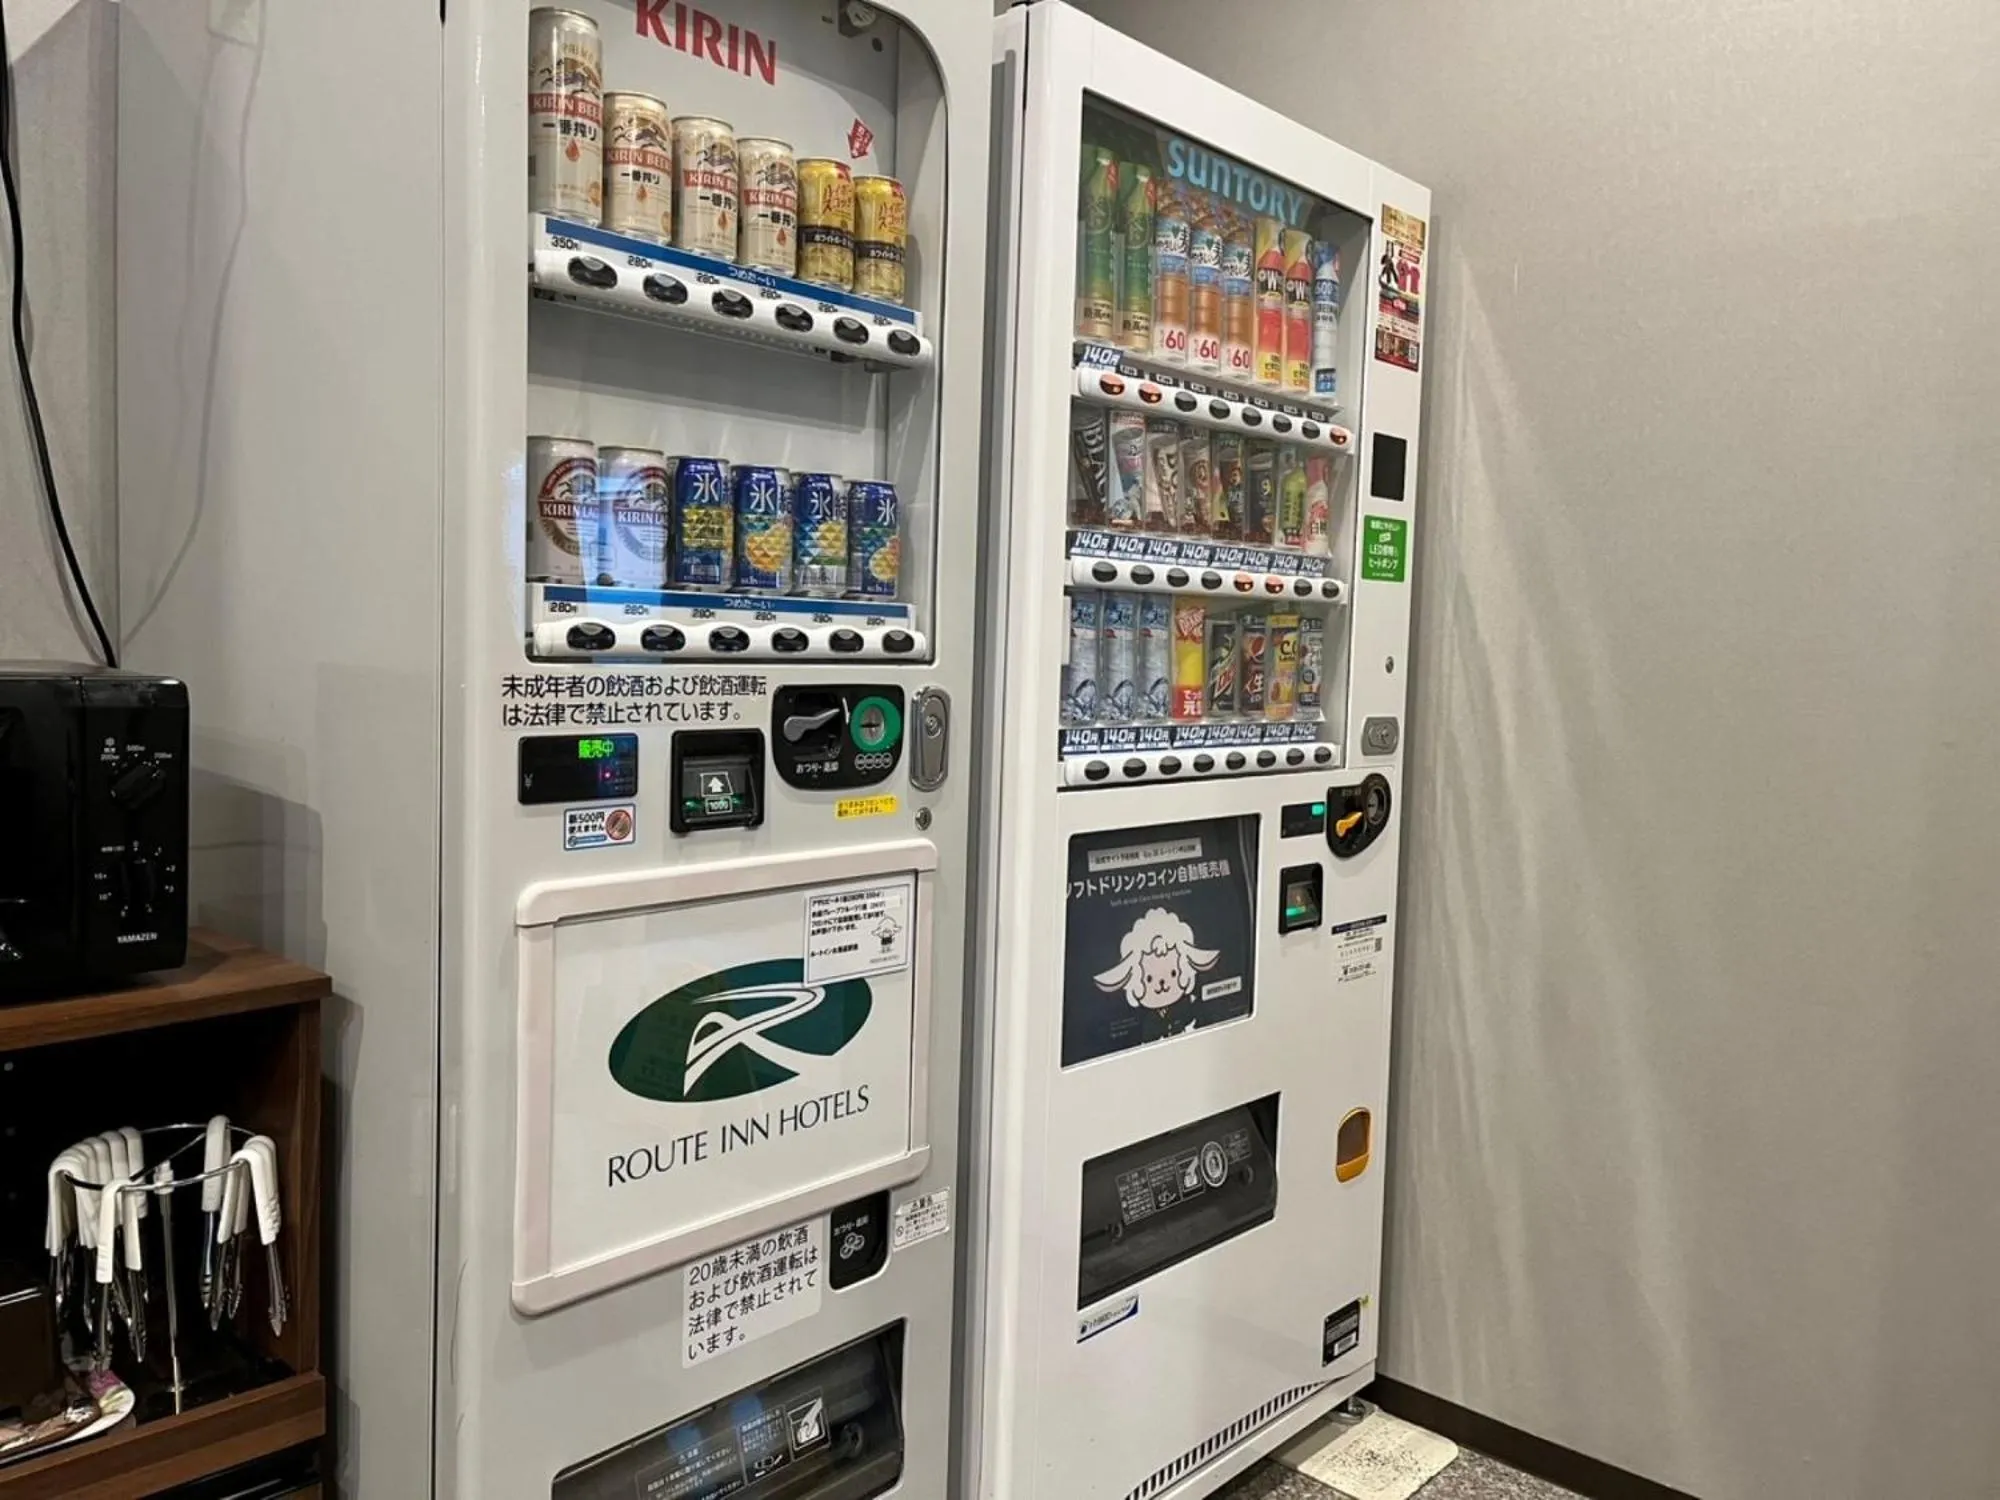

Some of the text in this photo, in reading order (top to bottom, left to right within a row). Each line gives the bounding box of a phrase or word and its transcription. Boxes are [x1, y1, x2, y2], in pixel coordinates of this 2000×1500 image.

[636, 0, 776, 85] KIRIN
[542, 119, 597, 141] 一番搾り
[1165, 330, 1186, 349] 60
[1199, 339, 1219, 360] 60
[1232, 349, 1250, 369] 60
[543, 503, 580, 518] KIRIN
[618, 511, 653, 524] KIRIN
[502, 675, 767, 699] 未成年者の飲酒および飲酒運転
[503, 701, 742, 727] は法律で禁止されています。
[116, 932, 158, 943] YAMAZEN
[608, 1084, 869, 1188] ROUTE INN HOTELS
[689, 1225, 809, 1286] 20歳未満の飲酒
[689, 1245, 818, 1311] および飲酒運転は
[688, 1268, 818, 1337] 法律で禁止されて
[688, 1325, 746, 1360] います。
